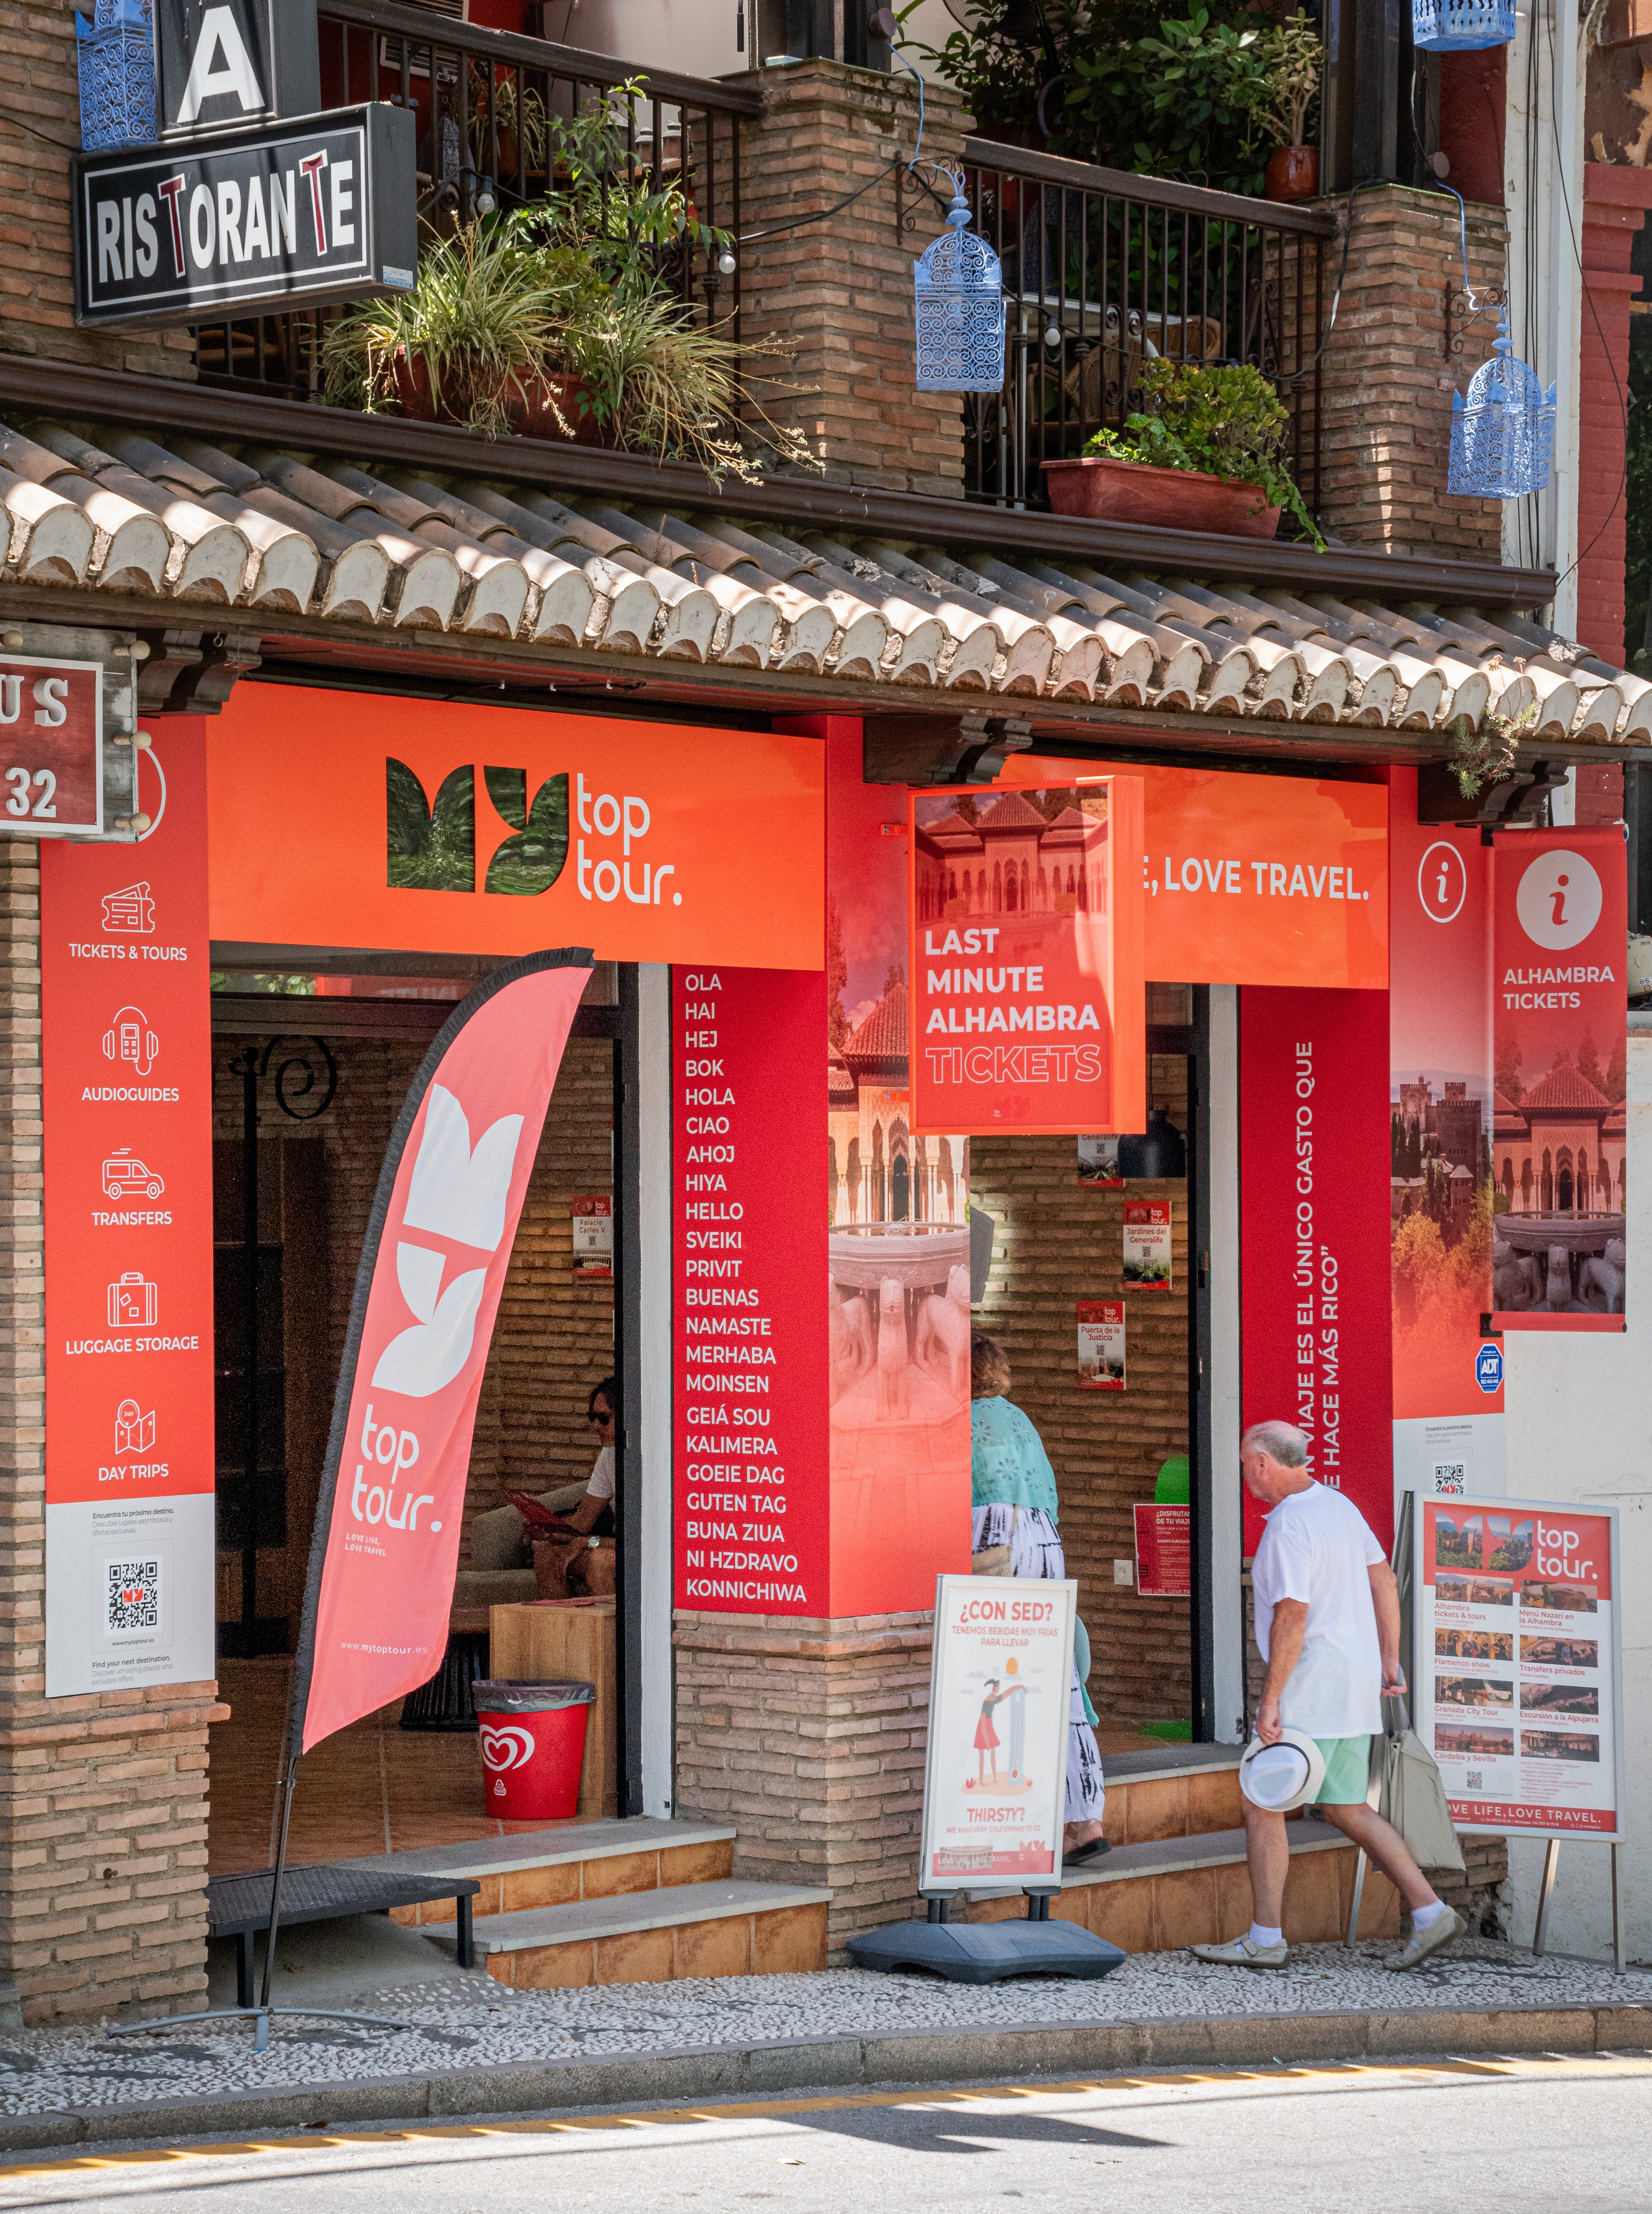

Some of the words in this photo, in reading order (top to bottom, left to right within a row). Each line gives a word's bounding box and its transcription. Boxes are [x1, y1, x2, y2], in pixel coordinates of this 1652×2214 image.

[97, 149, 355, 283] RISTORANTE
[5, 767, 57, 818] 32
[578, 773, 650, 855] top
[578, 839, 682, 906] tour.
[1165, 857, 1241, 893] LOVE
[1251, 861, 1369, 900] TRAVEL.
[926, 928, 1000, 955] LAST
[69, 943, 125, 959] TICKETS
[128, 946, 138, 959] &
[141, 946, 188, 961] TOURS
[685, 974, 722, 992] OLA
[927, 966, 1044, 994] MINUTE
[1503, 966, 1615, 985] ALHAMBRA
[1503, 992, 1580, 1009] TICKETS
[685, 1003, 714, 1019] HAI
[926, 1004, 1100, 1033] ALHAMBRA
[685, 1031, 717, 1048] HEJ
[686, 1059, 724, 1076] BOK
[926, 1044, 1102, 1084] TICKETS
[1296, 1041, 1315, 1100] QUE
[82, 1088, 179, 1102] AUDIOGUIDES
[686, 1088, 735, 1105] HOLA
[686, 1117, 729, 1134] CIAO
[686, 1146, 735, 1163] AHOJ
[1296, 1105, 1313, 1195] GASTO
[686, 1174, 727, 1191] HIYA
[92, 1211, 172, 1226] TRANSFERS
[686, 1203, 743, 1220] HELLO
[1151, 1208, 1163, 1218] top
[686, 1231, 742, 1249] SVEIKI
[1292, 1201, 1313, 1287] ÚNICO
[686, 1260, 743, 1277] PRIVIT
[686, 1289, 759, 1306] BUENAS
[1297, 1293, 1313, 1330] EL
[686, 1317, 771, 1336] NAMASTE
[66, 1338, 133, 1355] LUGGAGE
[136, 1336, 199, 1352] STORAGE
[1298, 1333, 1314, 1364] ES
[686, 1346, 776, 1364] MERHABA
[1319, 1328, 1339, 1386] MÁS
[1481, 1359, 1499, 1374] ADT
[686, 1375, 769, 1393] MOINSEN
[687, 1404, 728, 1425] GEIÁ
[733, 1407, 770, 1426] SOU
[1323, 1394, 1340, 1465] HACE
[361, 1404, 420, 1483] top
[686, 1436, 778, 1455] KALIMERA
[98, 1466, 126, 1481] DAY
[130, 1464, 169, 1478] TRIPS
[687, 1464, 742, 1483] GOEIE
[747, 1466, 785, 1485] DAG
[351, 1464, 442, 1533] tour.
[687, 1493, 747, 1512] GUTEN
[752, 1495, 786, 1513] TAG
[129, 1509, 152, 1517] próximo
[346, 1533, 364, 1542] LOVE
[366, 1536, 380, 1545] LIVE,
[687, 1521, 738, 1540] BUNA
[743, 1523, 784, 1542] ZIUA
[1537, 1520, 1579, 1556] top
[345, 1543, 363, 1552] LOVE
[364, 1546, 386, 1556] TRAVEL
[687, 1550, 704, 1568] NI
[710, 1552, 798, 1572] HZDRAVO
[1537, 1549, 1597, 1580] tour.
[686, 1578, 807, 1602] KONNICHIWA
[960, 1600, 1006, 1623] ¿CON
[1011, 1602, 1053, 1621] SED?
[952, 1625, 986, 1634] TENEMOS
[988, 1627, 1019, 1635] BEBIDAS
[1038, 1626, 1058, 1636] FRÍAS
[1528, 1618, 1562, 1626] Alhambra
[341, 1642, 427, 1654] www.mytoptour.es
[981, 1637, 1000, 1646] PARA
[136, 1655, 171, 1664] destination.
[1520, 1665, 1553, 1673] Transfers
[1434, 1752, 1465, 1760] Córdoba
[967, 1807, 1025, 1822] THIRSTY?
[1547, 1810, 1601, 1823] TRAVEL.
